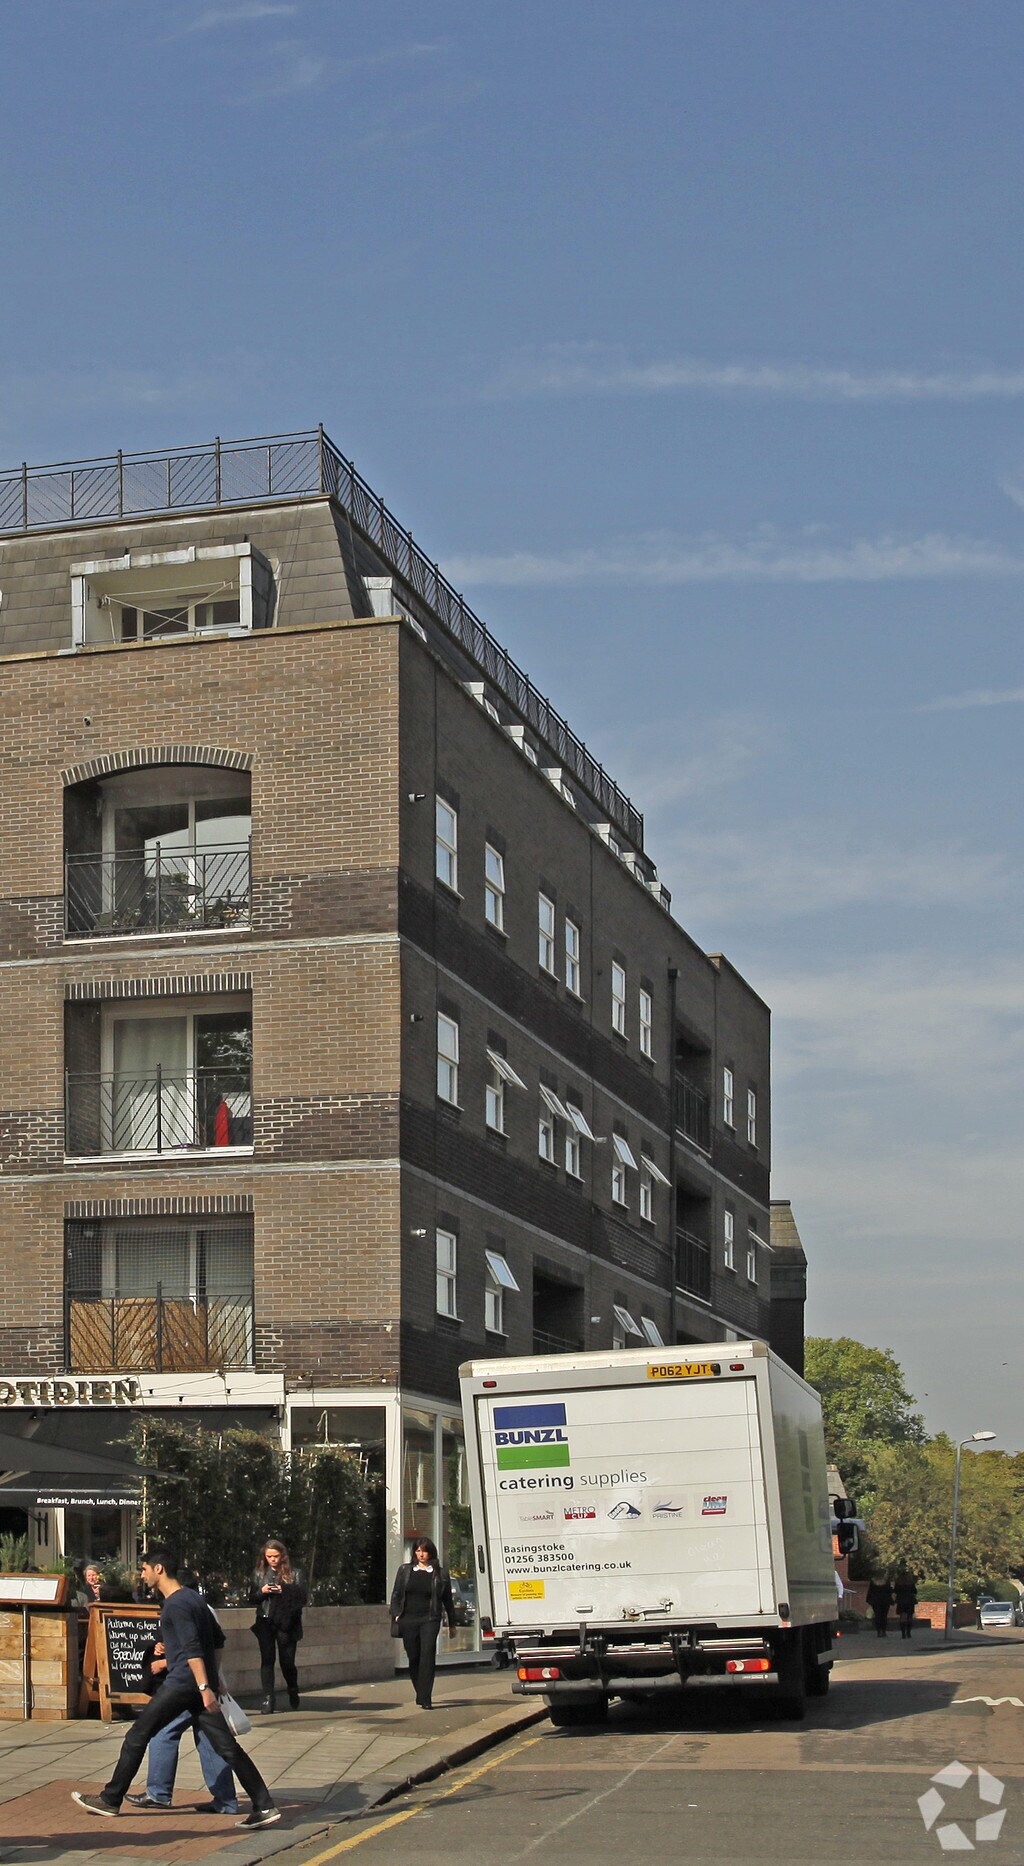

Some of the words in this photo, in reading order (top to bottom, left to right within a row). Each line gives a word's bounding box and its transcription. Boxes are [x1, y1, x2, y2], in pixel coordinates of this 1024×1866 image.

[685, 1364, 708, 1375] YJT
[494, 1428, 568, 1446] BUNZL
[499, 1473, 575, 1490] catering
[580, 1469, 648, 1487] supplies
[36, 1497, 70, 1505] Breakfast,
[70, 1498, 96, 1506] Brunch,
[96, 1498, 118, 1506] Lunch,
[563, 1505, 596, 1515] METRO
[503, 1543, 565, 1555] Basingstoke
[505, 1554, 535, 1564] 01256
[537, 1552, 574, 1562] 383500
[506, 1560, 632, 1575] www.bunzlcatering.co.uk
[107, 1618, 135, 1629] Autumn
[136, 1621, 144, 1630] is
[129, 1632, 139, 1642] up
[140, 1631, 156, 1641] with
[120, 1640, 134, 1649] new
[112, 1648, 146, 1661] Speculoo
